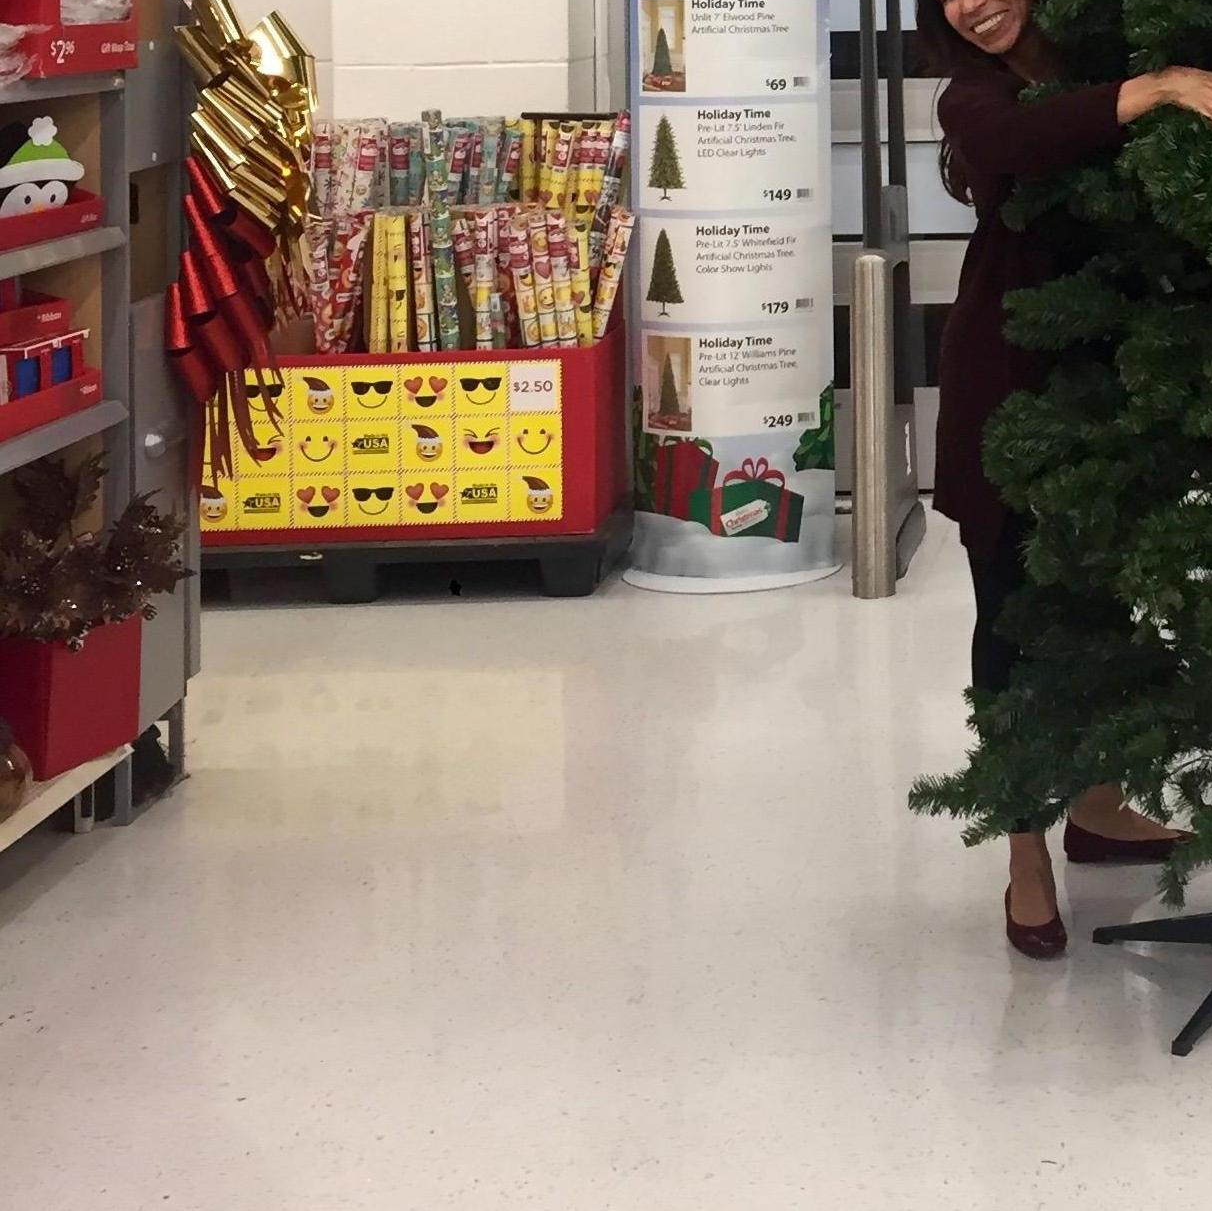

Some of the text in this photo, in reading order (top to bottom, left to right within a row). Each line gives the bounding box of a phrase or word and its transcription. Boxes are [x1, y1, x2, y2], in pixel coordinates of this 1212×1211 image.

[691, 13, 712, 22] Unlit
[723, 13, 755, 21] Elwood
[757, 12, 775, 20] Pine
[691, 26, 726, 34] Artificial
[728, 25, 770, 34] Christmas
[766, 78, 787, 90] $69
[697, 109, 771, 121] Holiday Time
[743, 122, 772, 131] Linden
[774, 121, 784, 130] Fir
[697, 136, 732, 145] Artificial
[734, 135, 776, 144] Christmas
[697, 148, 766, 158] LED Clear Lights
[763, 189, 792, 201] $149
[696, 224, 770, 237] Holiday Time
[786, 236, 797, 244] Fir
[696, 252, 731, 261] Artificial
[733, 251, 775, 260] Christmas
[696, 263, 773, 274] Color Show Lights
[761, 301, 789, 314] $179
[699, 336, 773, 349] Holiday Time
[778, 348, 796, 356] Pine
[699, 364, 734, 374] Artificial
[736, 363, 777, 372] Christmas
[513, 380, 553, 392] $2.50
[699, 377, 749, 387] Clear Lights
[763, 415, 793, 428] $249
[364, 438, 388, 449] USA
[472, 487, 497, 498] USA
[255, 497, 280, 508] USA
